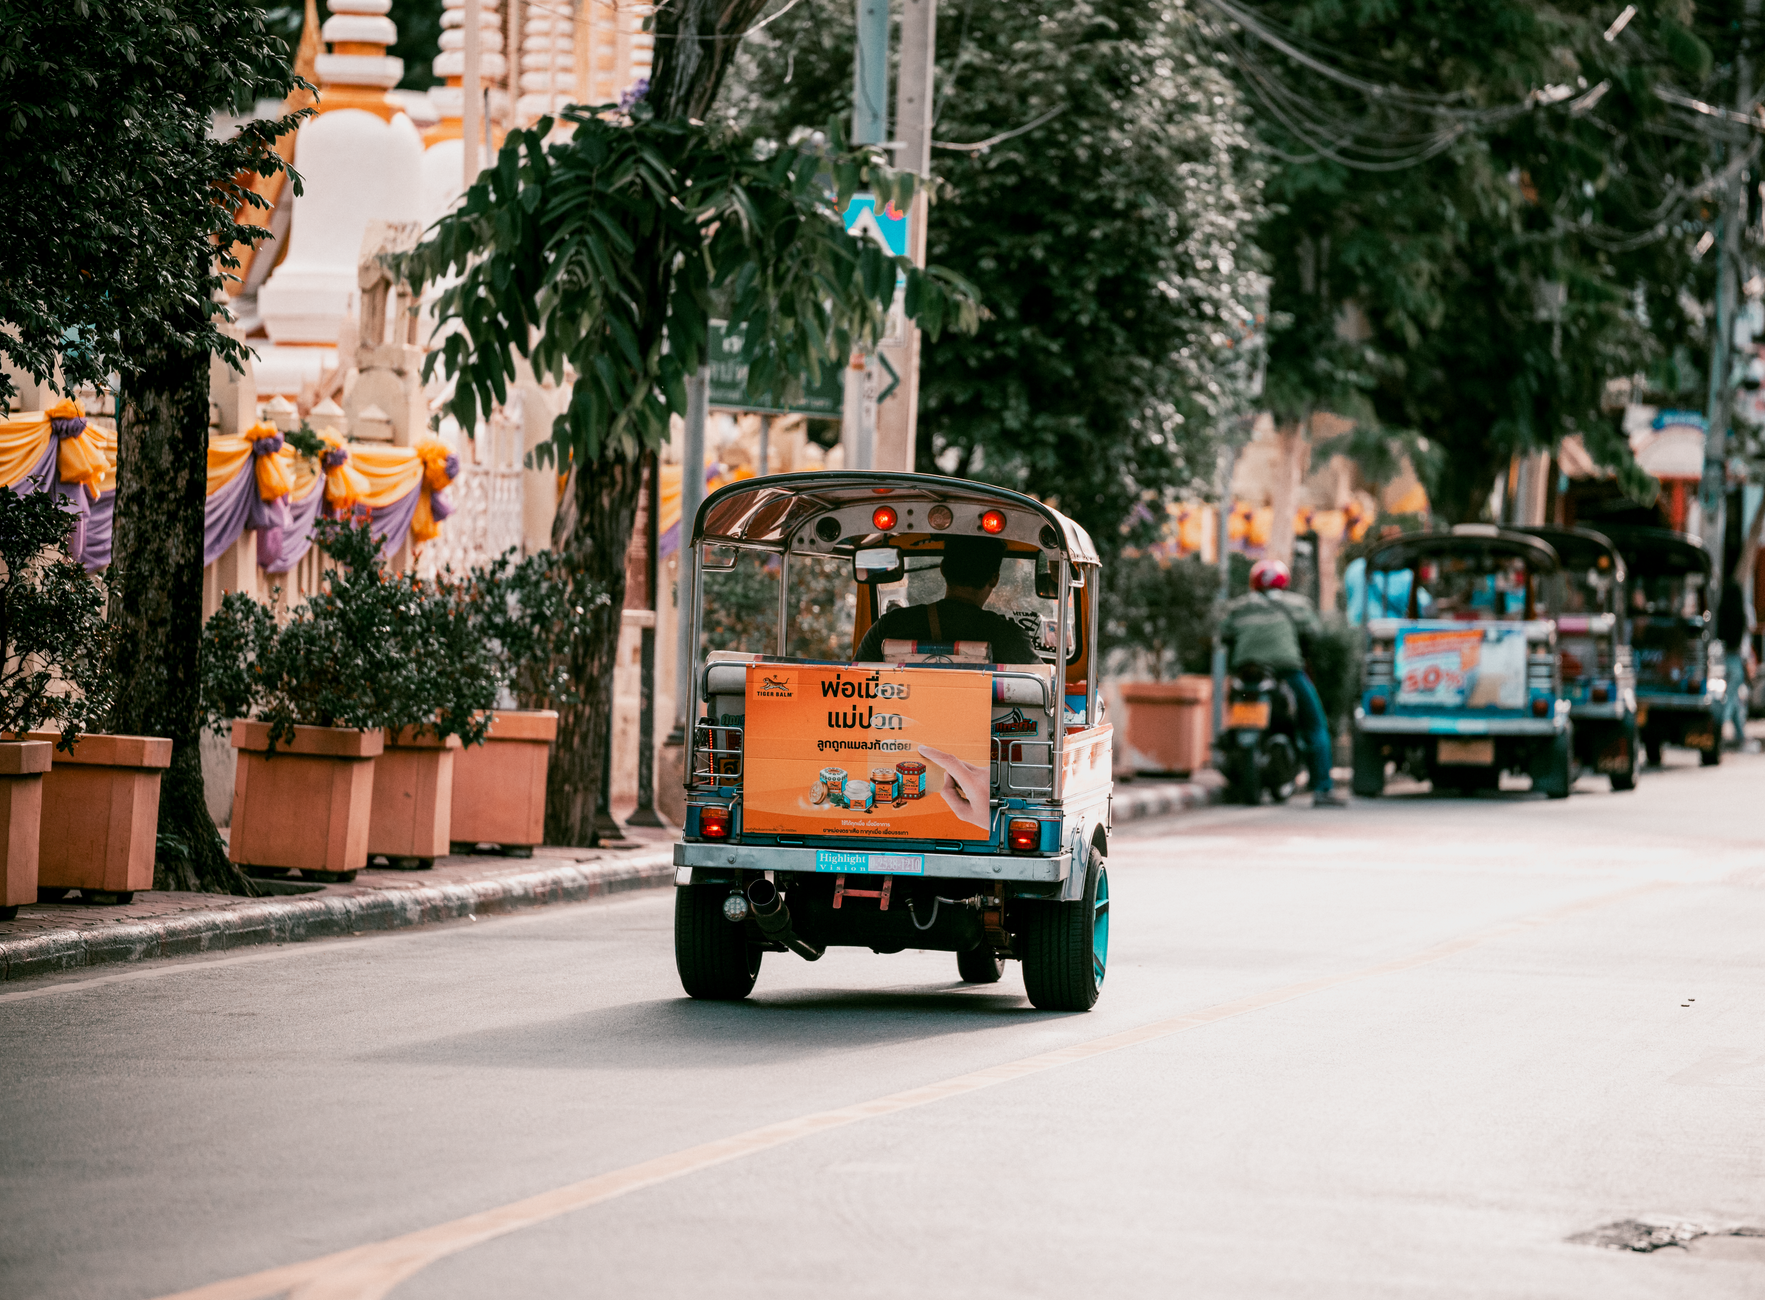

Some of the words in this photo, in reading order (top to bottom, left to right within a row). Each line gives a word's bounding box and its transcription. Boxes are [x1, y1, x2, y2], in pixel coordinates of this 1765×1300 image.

[821, 670, 911, 700] พ่อเมื่อย
[828, 704, 902, 730] แม่ปวด
[817, 739, 911, 752] ลูกถูกแมลงกัดต่อย
[820, 853, 866, 865] Highlight
[820, 864, 866, 872] Vision
